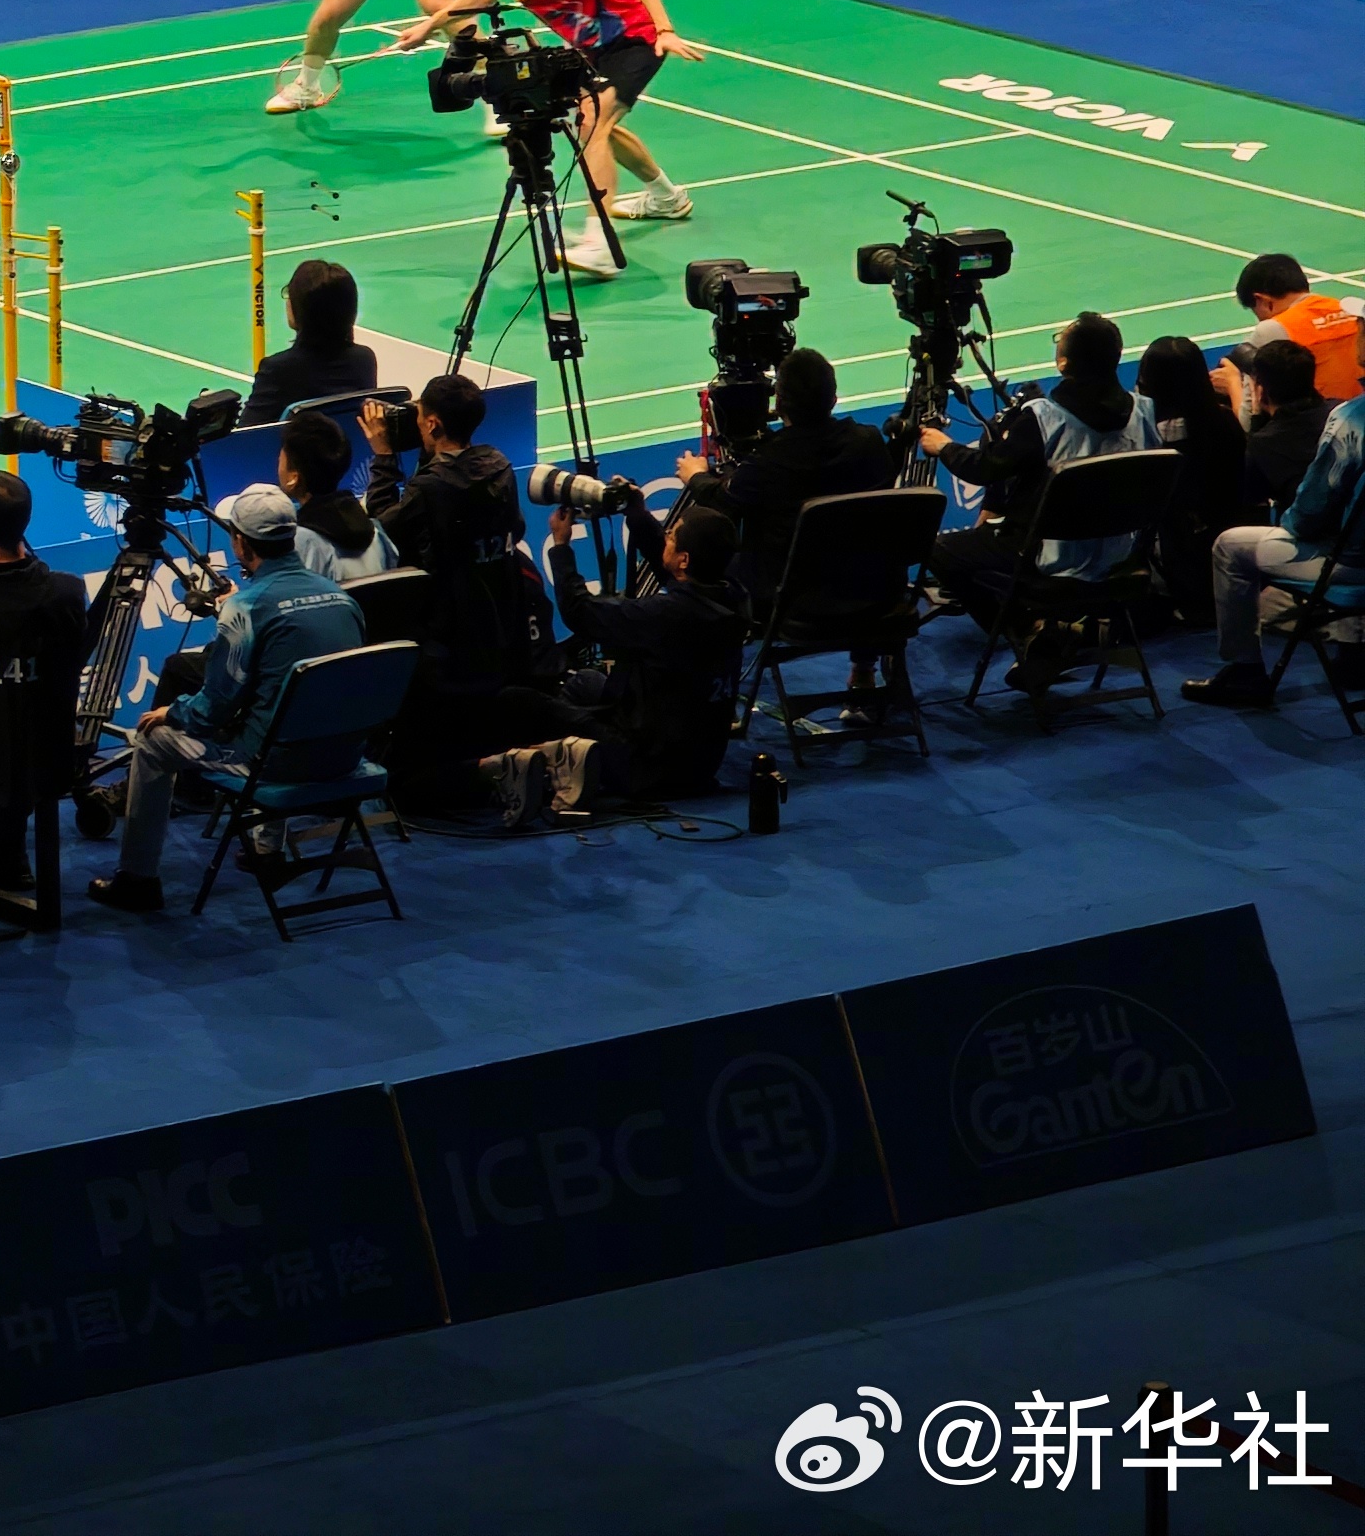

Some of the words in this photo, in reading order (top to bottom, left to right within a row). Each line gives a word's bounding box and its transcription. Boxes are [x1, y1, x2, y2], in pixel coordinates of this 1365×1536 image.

[939, 74, 1176, 141] VICTOR
[985, 1005, 1134, 1076] 百岁山
[87, 1152, 263, 1256] PICC
[446, 1111, 681, 1237] ICBC
[0, 1234, 392, 1365] 中国人民保险
